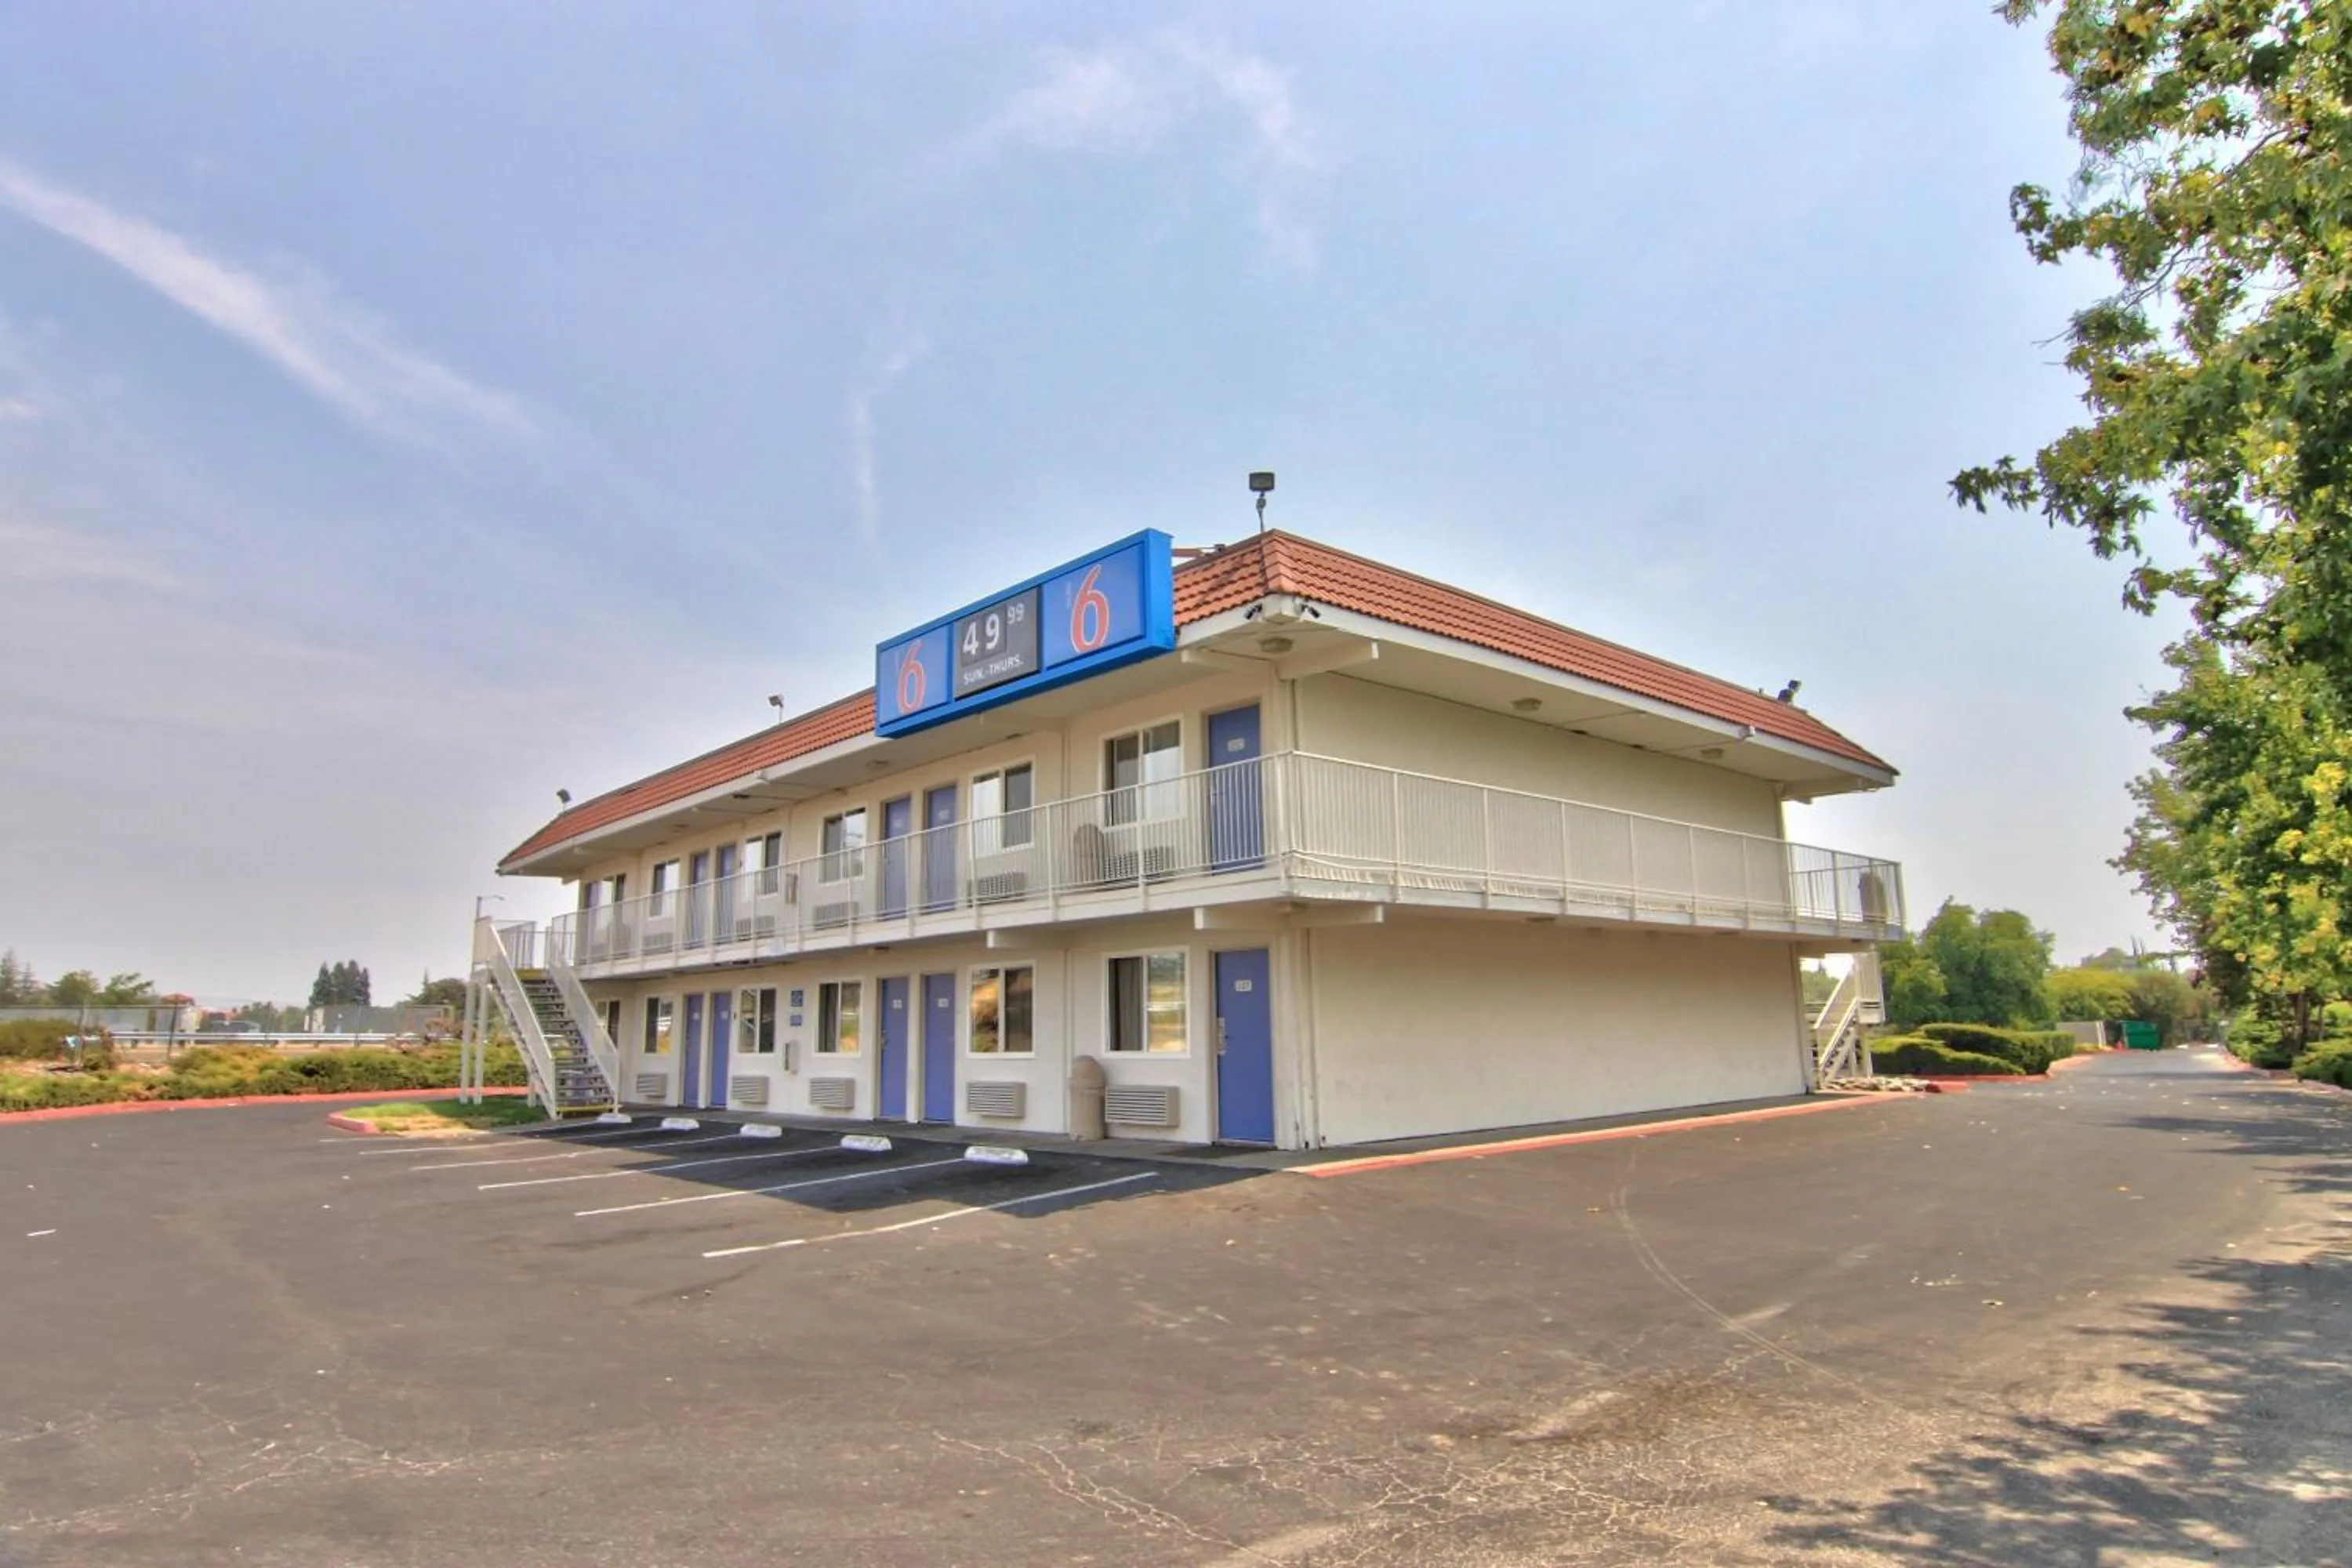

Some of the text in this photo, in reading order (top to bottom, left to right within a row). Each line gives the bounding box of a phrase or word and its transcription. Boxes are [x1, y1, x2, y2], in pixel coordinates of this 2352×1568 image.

[963, 613, 1000, 655] 49
[1069, 564, 1110, 653] 6
[896, 639, 925, 715] 6
